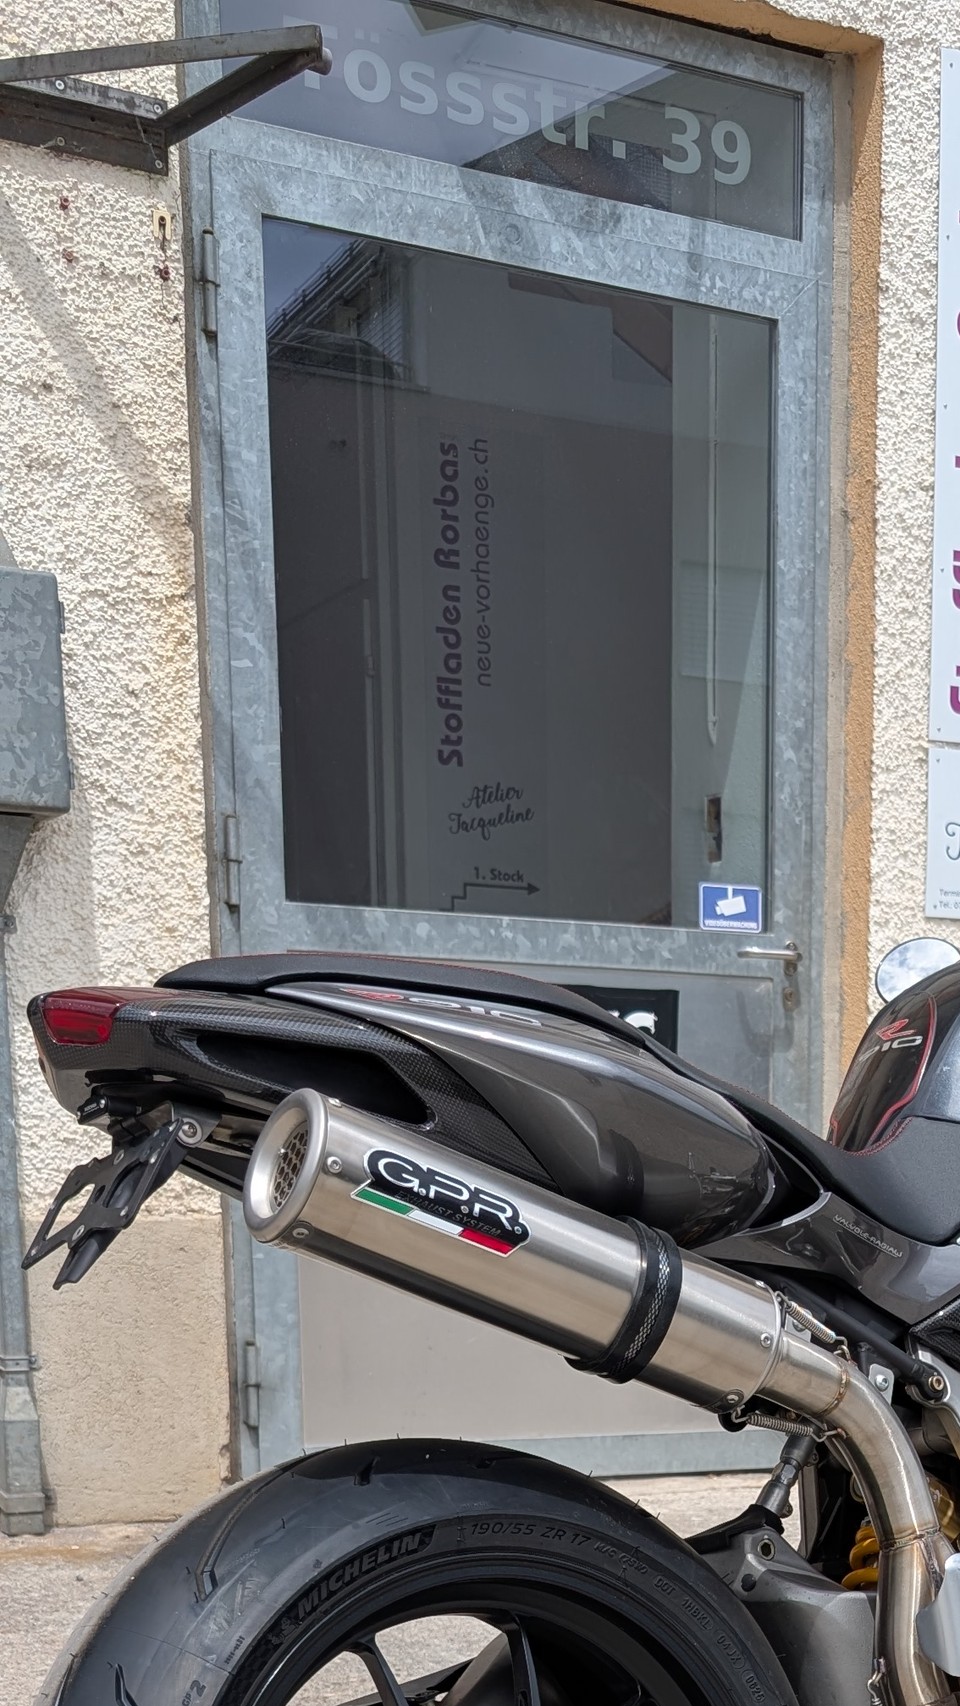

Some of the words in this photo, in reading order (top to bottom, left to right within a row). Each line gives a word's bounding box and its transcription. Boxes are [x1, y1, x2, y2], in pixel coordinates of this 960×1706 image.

[662, 103, 753, 186] 39
[433, 441, 461, 570] Rorbas
[467, 438, 495, 688] neue-vorhaenge.ch
[435, 584, 464, 768] Stoffladen
[462, 781, 524, 809] Atelier
[447, 803, 536, 842] Jacqueline
[474, 866, 487, 881] 1.
[489, 868, 524, 883] Stock
[395, 1190, 451, 1218] EXHAUST
[452, 1210, 502, 1237] SYSTEM
[471, 1522, 537, 1536] 190/55
[540, 1526, 567, 1541] ZR
[570, 1533, 592, 1547] 17
[298, 1532, 423, 1619] MICHELIN
[655, 1574, 678, 1596] DOT
[189, 1679, 207, 1698] 2
